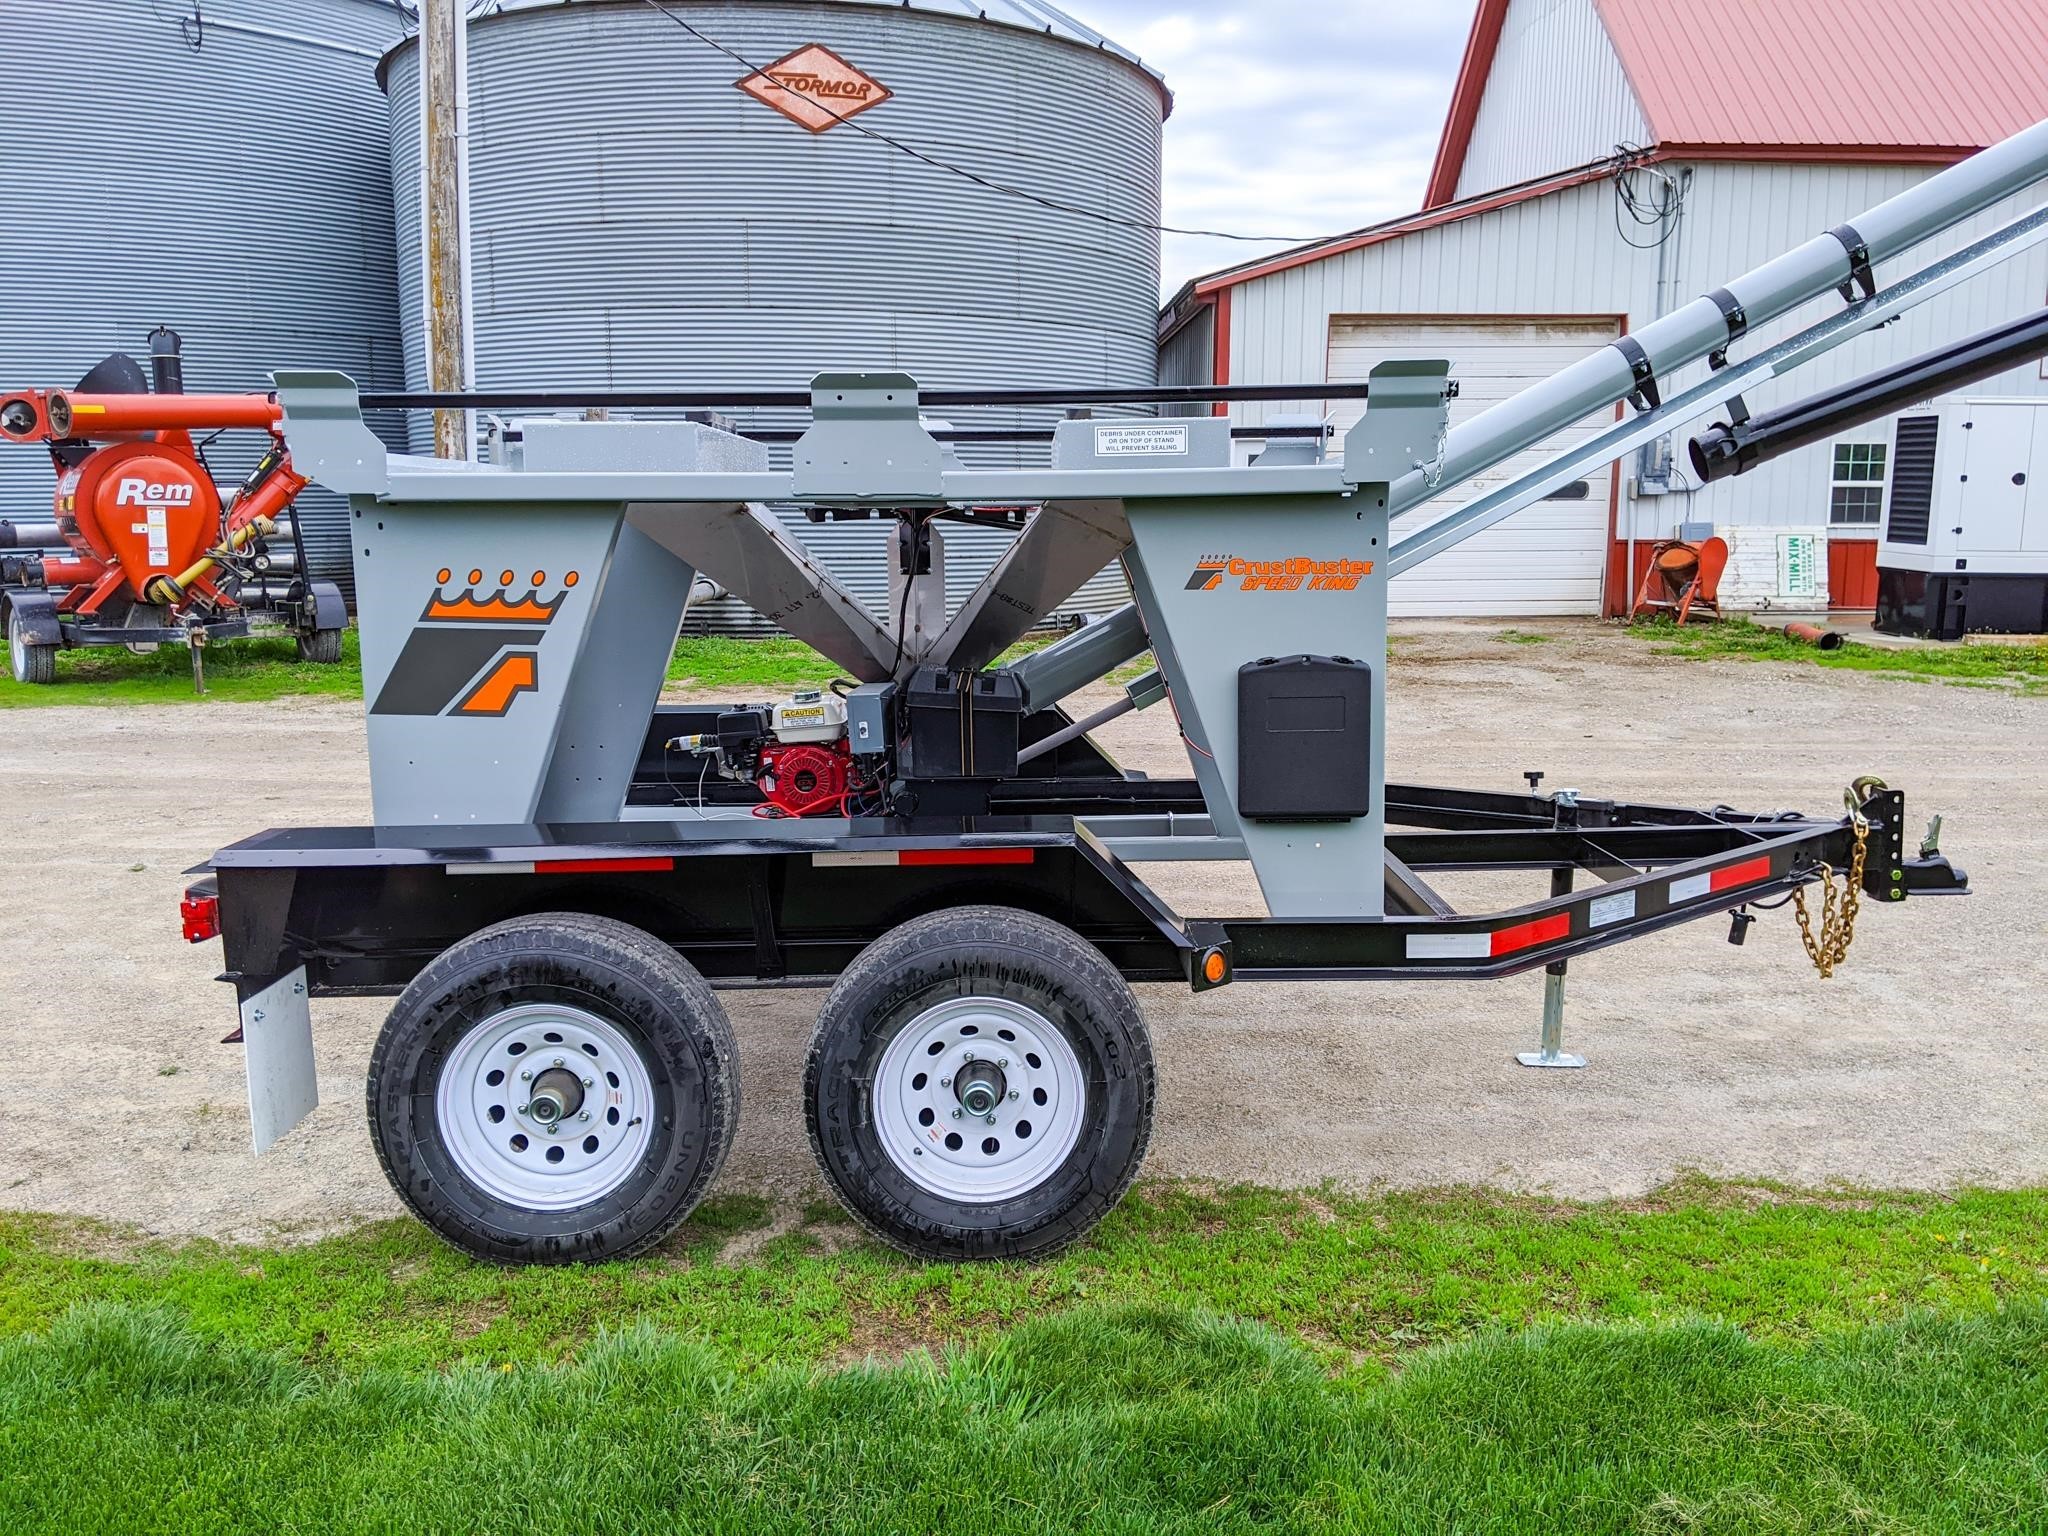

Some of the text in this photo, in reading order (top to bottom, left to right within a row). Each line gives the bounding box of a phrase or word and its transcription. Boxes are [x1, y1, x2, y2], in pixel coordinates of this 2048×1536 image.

[116, 478, 193, 506] Rem
[1228, 558, 1374, 575] CrustBuster
[1240, 575, 1363, 591] SPEED KING
[790, 708, 821, 717] CAUTION
